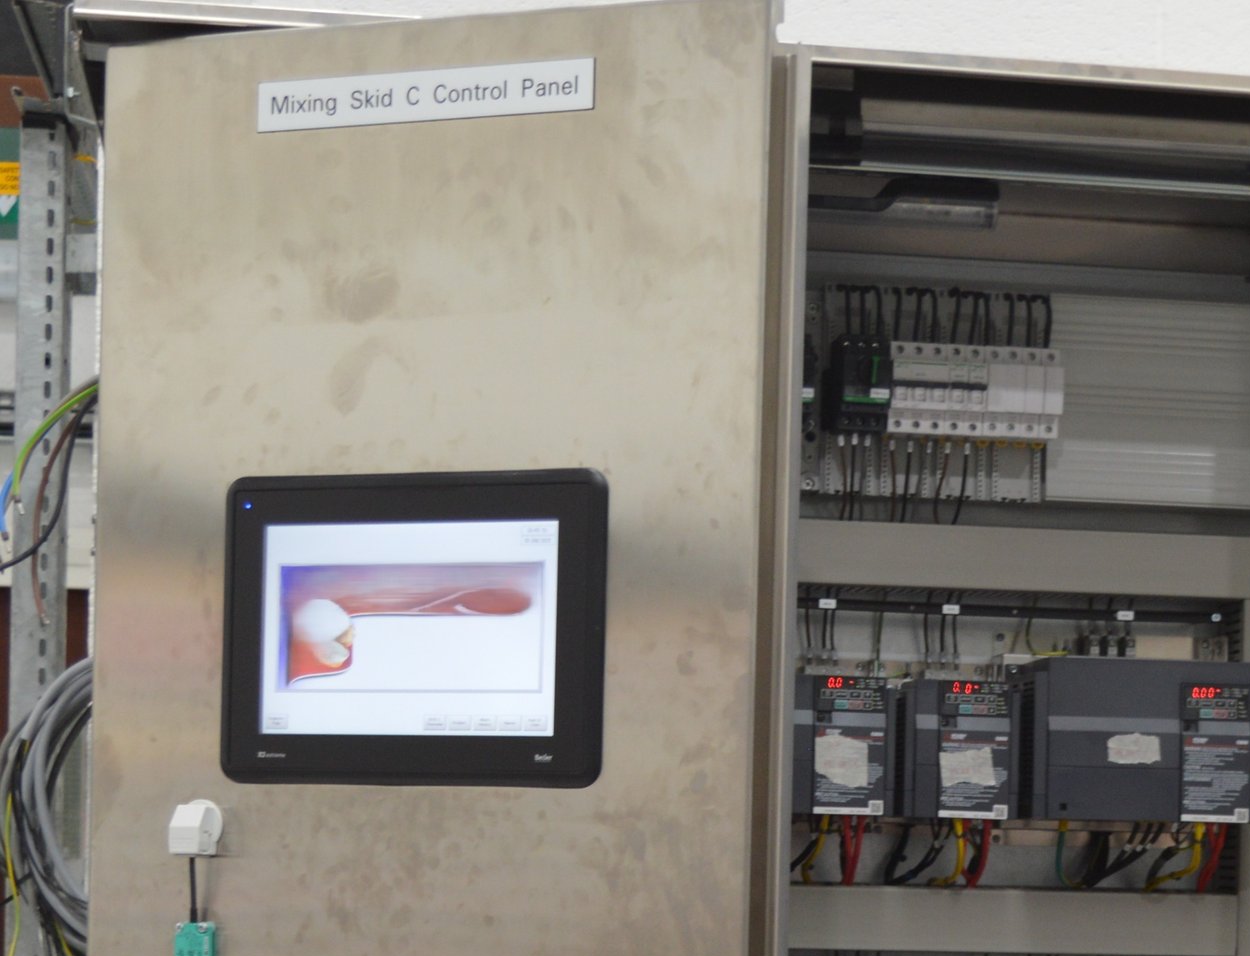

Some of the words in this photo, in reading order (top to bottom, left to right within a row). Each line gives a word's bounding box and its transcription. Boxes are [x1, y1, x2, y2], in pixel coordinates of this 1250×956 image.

[270, 93, 337, 116] Mixing
[350, 87, 393, 111] Skid
[405, 85, 421, 107] C
[433, 79, 508, 104] Control
[521, 75, 580, 98] Panel
